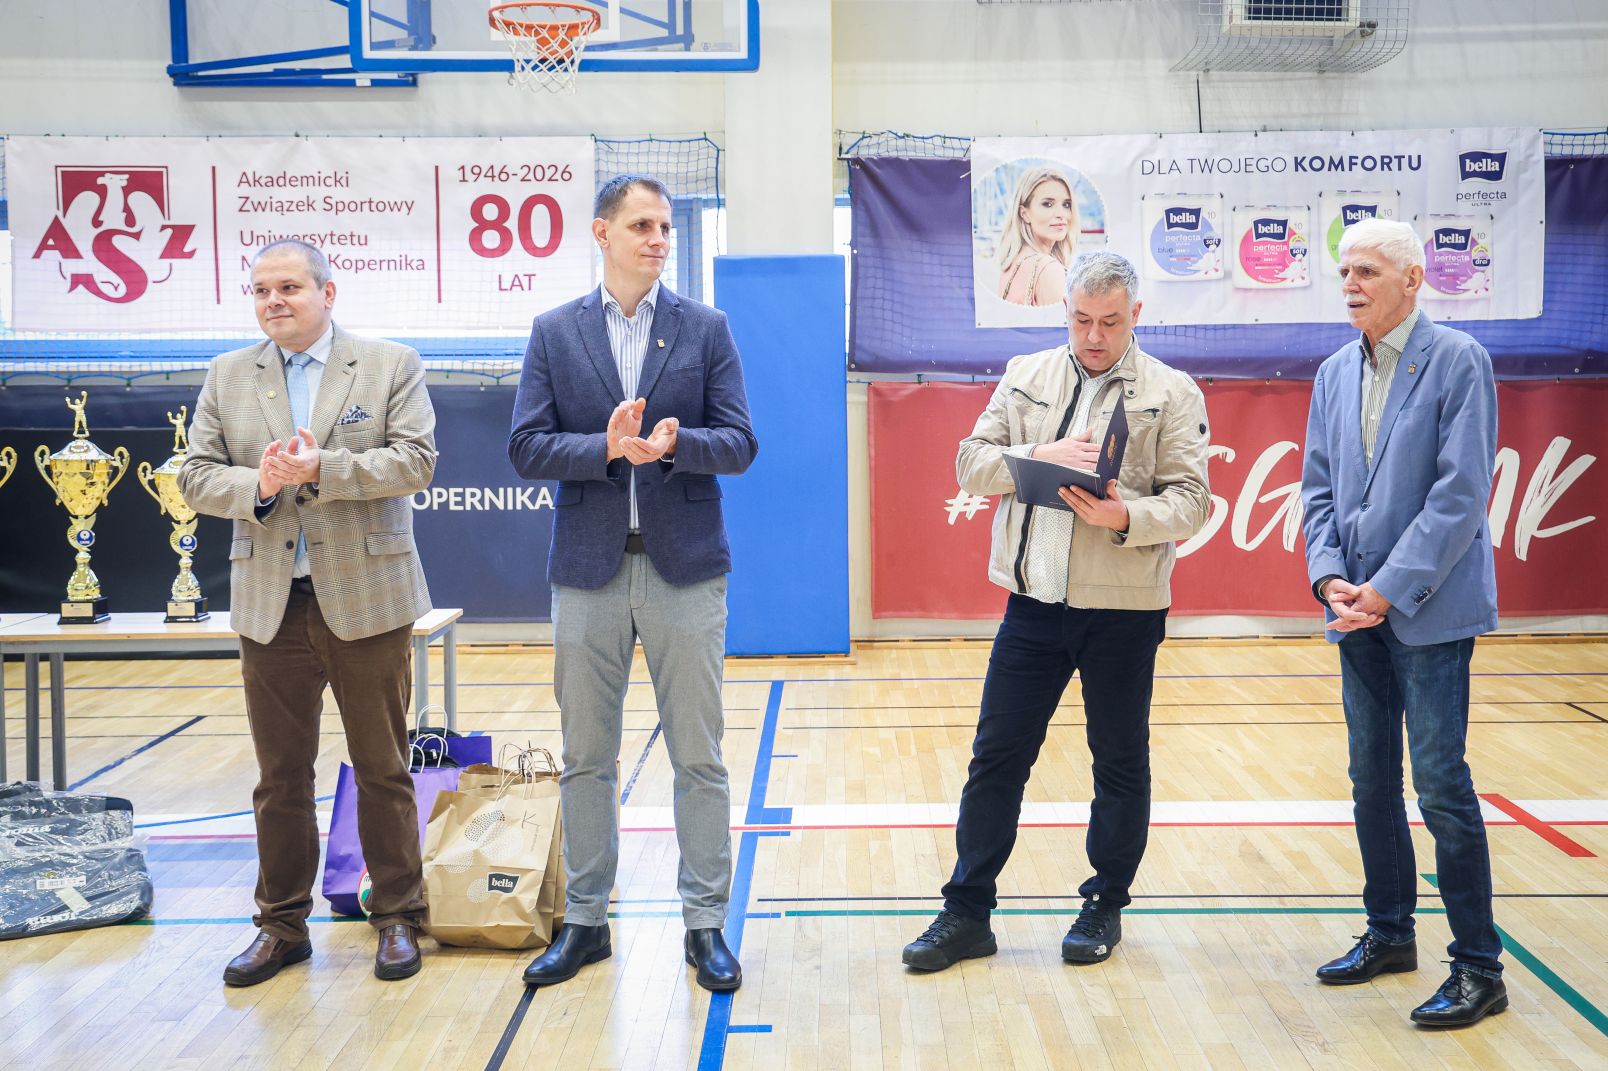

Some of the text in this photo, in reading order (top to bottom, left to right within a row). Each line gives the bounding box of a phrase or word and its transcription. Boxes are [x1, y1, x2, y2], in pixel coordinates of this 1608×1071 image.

[1141, 155, 1422, 175] DLA TWOJEGO KOMFORTU
[1465, 158, 1500, 172] bella
[237, 171, 350, 188] Akademicki
[457, 164, 573, 183] 1946-2026
[1456, 190, 1507, 203] perfecta
[238, 195, 415, 216] Związek Sportowy
[1169, 212, 1197, 224] bella
[1346, 209, 1372, 220] bella
[1383, 208, 1393, 217] 10
[468, 193, 564, 259] 80
[1258, 223, 1284, 234] bella
[1439, 233, 1466, 244] bella
[1477, 232, 1486, 240] 10
[1253, 244, 1289, 253] perfecta
[328, 254, 426, 274] Kopernika
[1434, 253, 1470, 263] perfecta
[498, 273, 536, 291] LAT
[410, 486, 556, 511] OPERNIKA
[491, 877, 514, 888] bella
